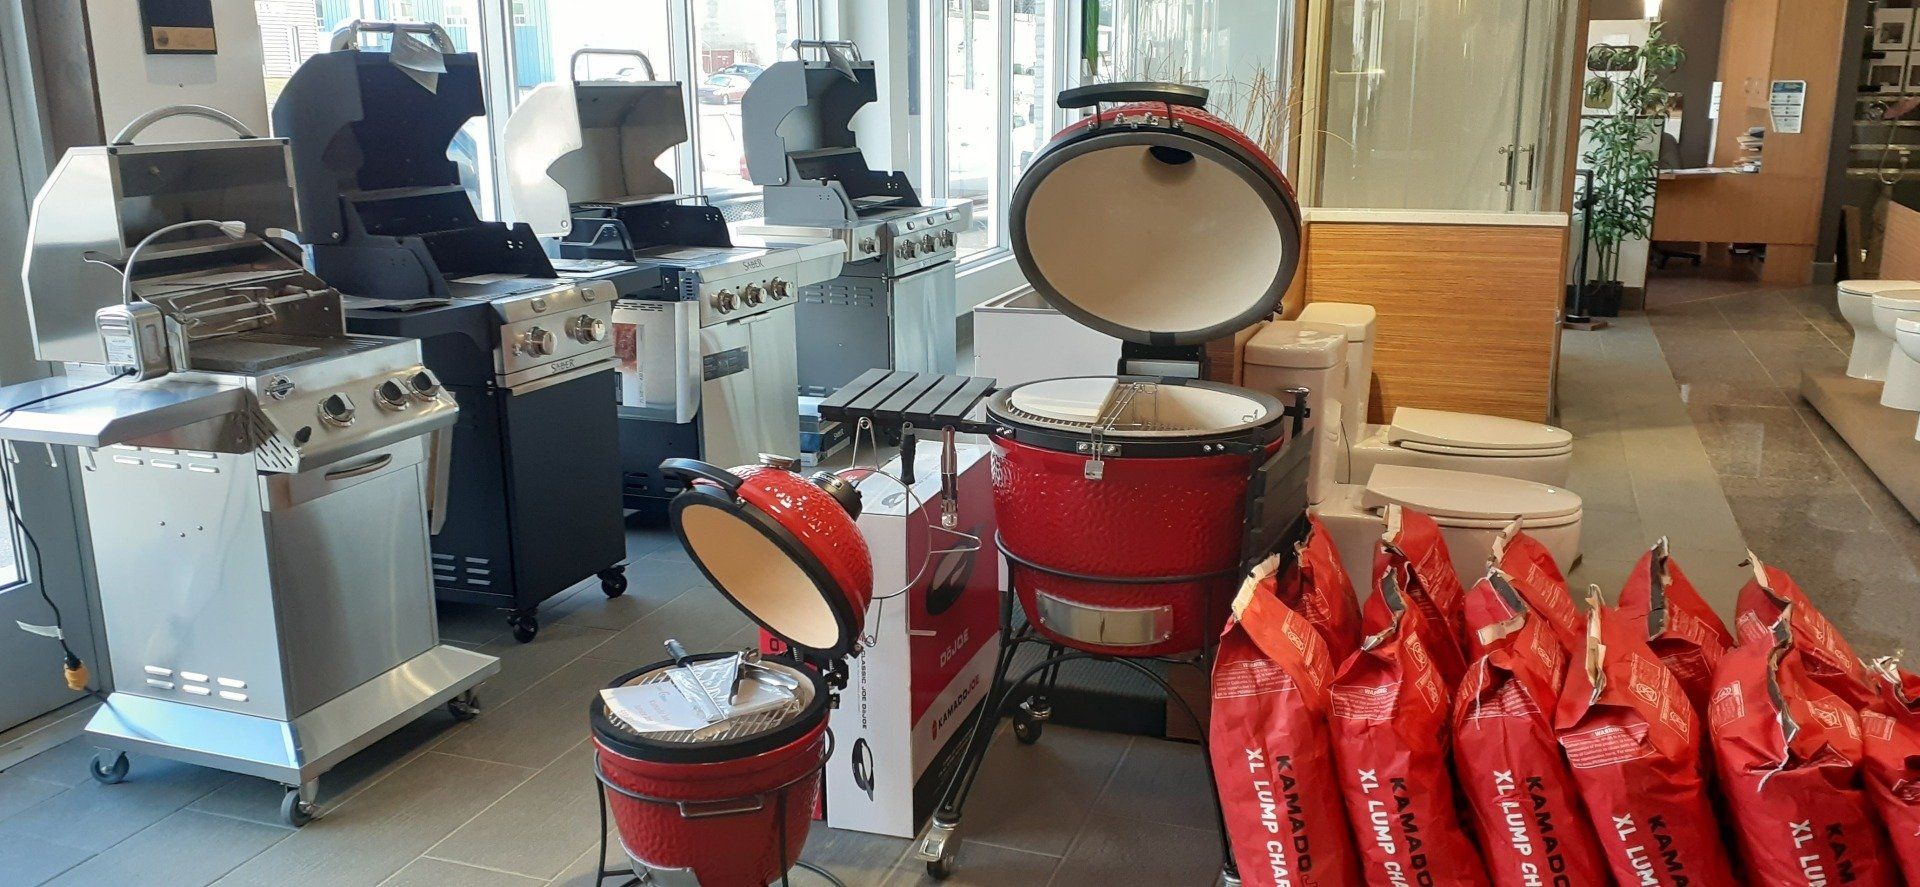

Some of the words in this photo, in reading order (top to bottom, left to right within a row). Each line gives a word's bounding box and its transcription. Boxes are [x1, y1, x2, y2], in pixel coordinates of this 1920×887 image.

[743, 258, 765, 271] SABER
[1245, 747, 1266, 774] XL
[1357, 768, 1379, 794] XL
[1493, 769, 1515, 796] XL
[1253, 780, 1279, 834] LUMP
[1367, 800, 1396, 855] LUMP
[1501, 801, 1533, 856] LUMP
[1611, 812, 1637, 841] XL
[1788, 819, 1814, 849] XL
[1521, 862, 1543, 887] CH
